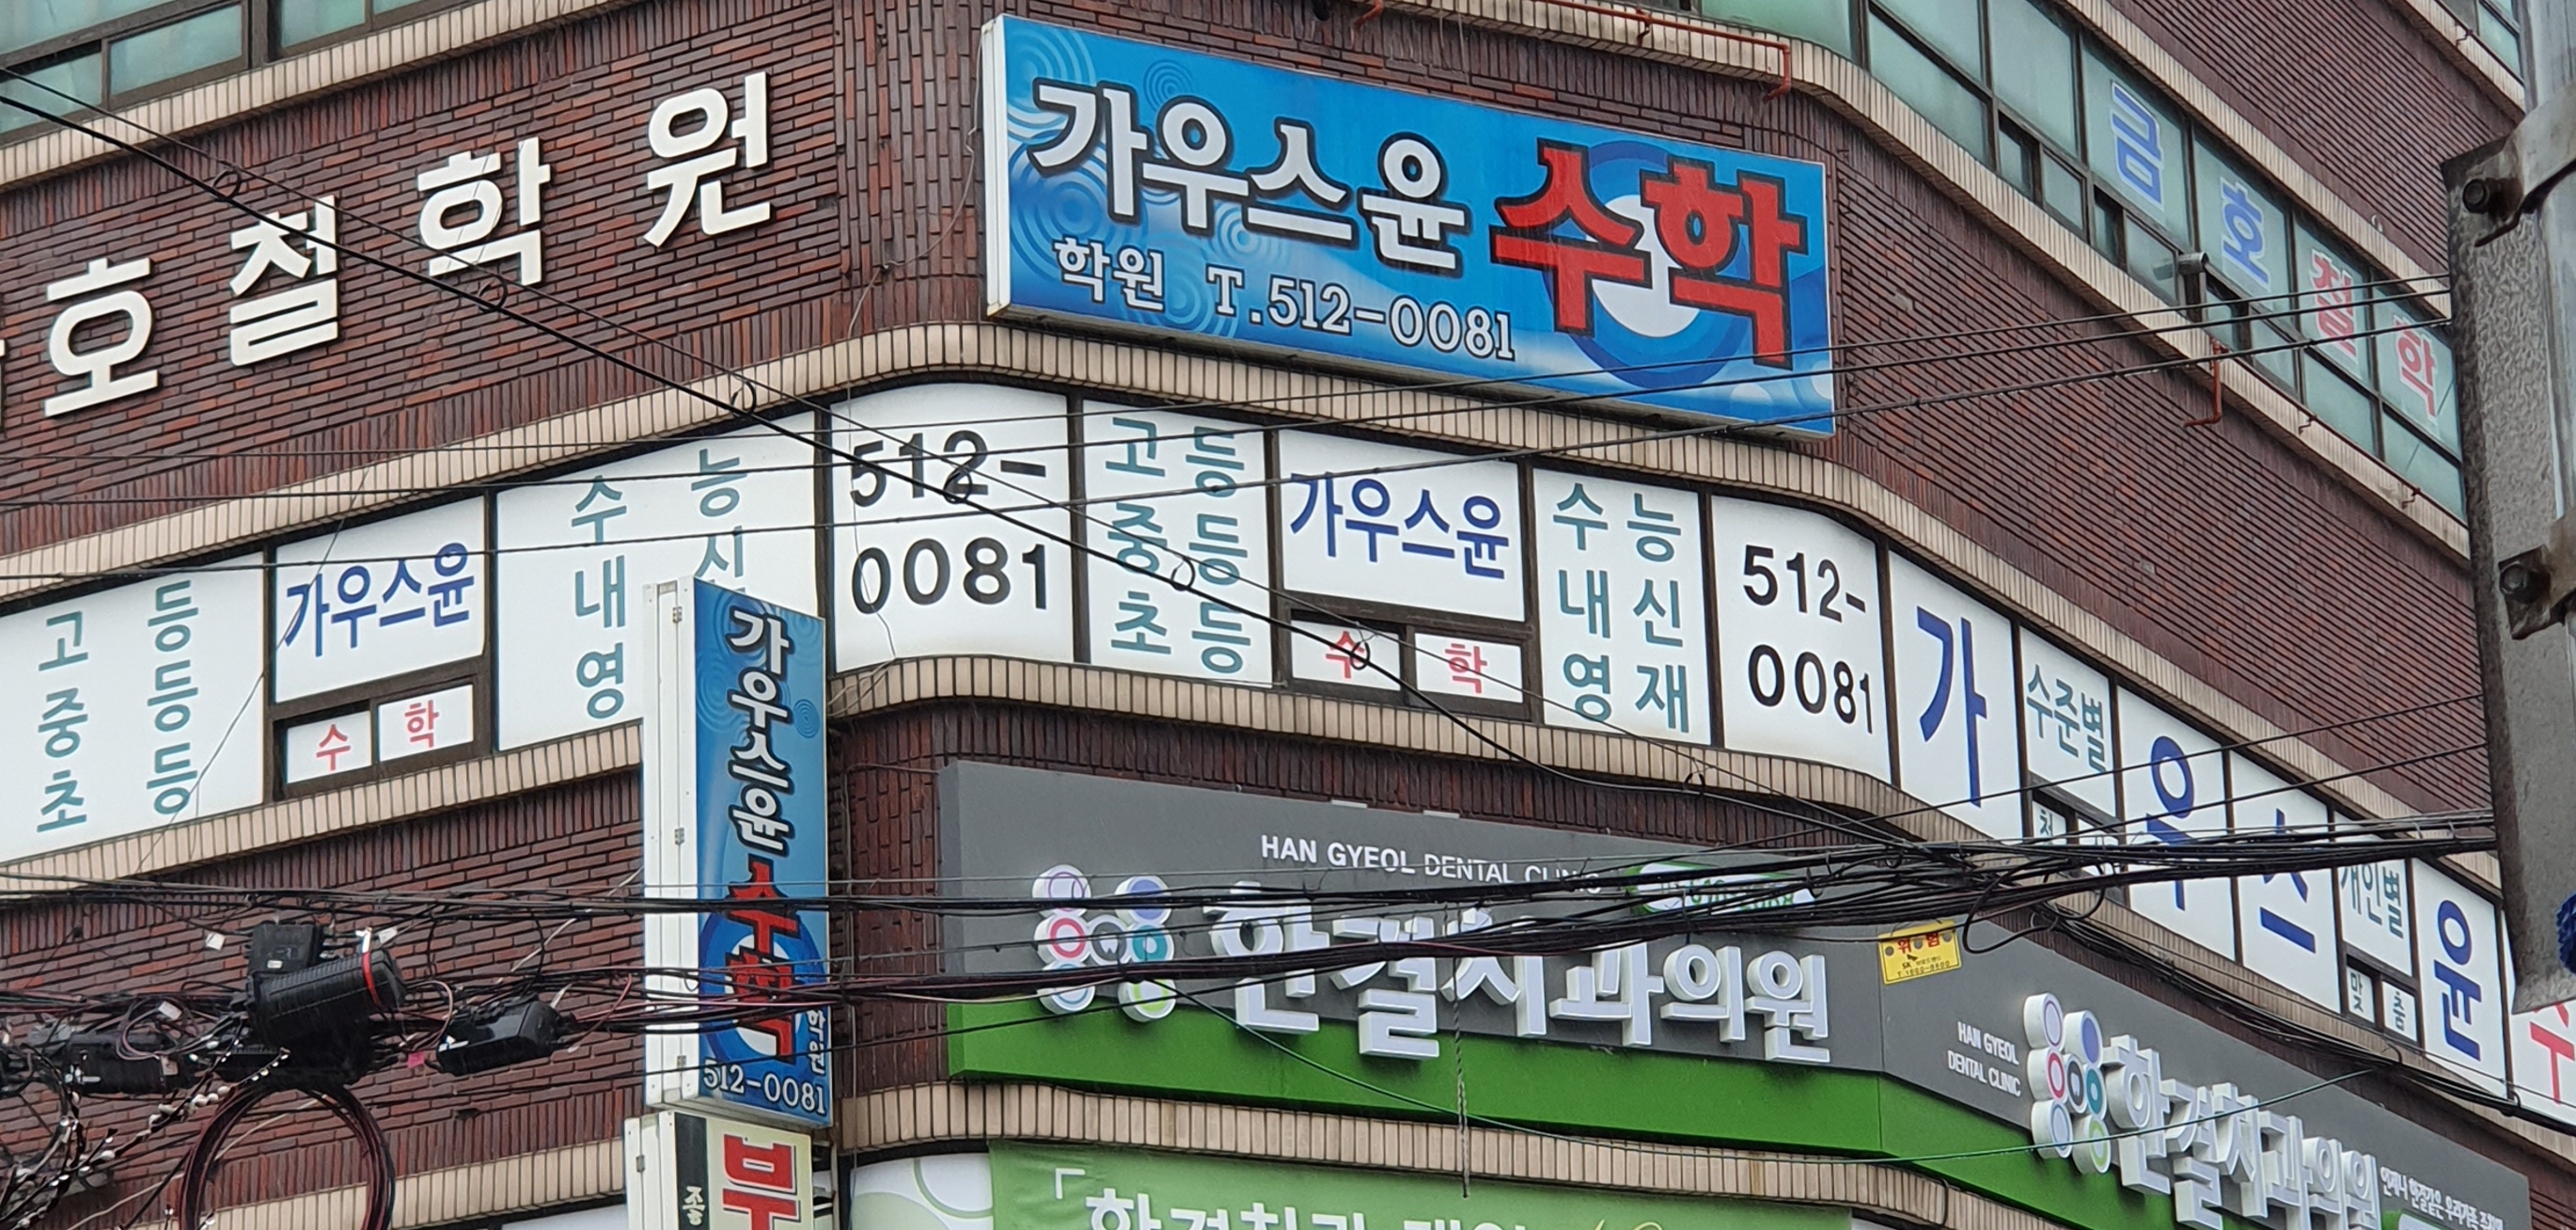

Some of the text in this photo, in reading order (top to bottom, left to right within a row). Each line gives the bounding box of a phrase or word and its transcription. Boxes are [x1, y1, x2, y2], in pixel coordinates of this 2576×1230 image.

[0, 71, 772, 418] 호철학원
[1028, 79, 1806, 368] 가우스윤 수학
[1055, 236, 1165, 311] 학원
[1290, 473, 1509, 579] 가우스윤
[284, 542, 476, 658] 가우스윤
[851, 537, 1048, 615] 0081
[1743, 544, 1866, 623] 512-
[1748, 644, 1873, 734] 0081
[2027, 663, 2107, 773] 수준별
[726, 607, 804, 1064] 가우스윤 수학
[1261, 834, 1317, 863] HAN
[1327, 842, 1416, 875] GYEOL
[1424, 853, 1515, 884] DENTAL
[1203, 881, 1830, 1064] 한결치과의원
[1897, 932, 1940, 954] 위험
[807, 1008, 826, 1075] 학원
[1947, 1049, 2021, 1096] DENTAL CLINIC
[1957, 1021, 2019, 1064] HAN GYEOL
[702, 1058, 826, 1115] 512-0081
[2103, 1034, 2381, 1230] 한결치과의원
[2380, 1166, 2408, 1201] 언제나
